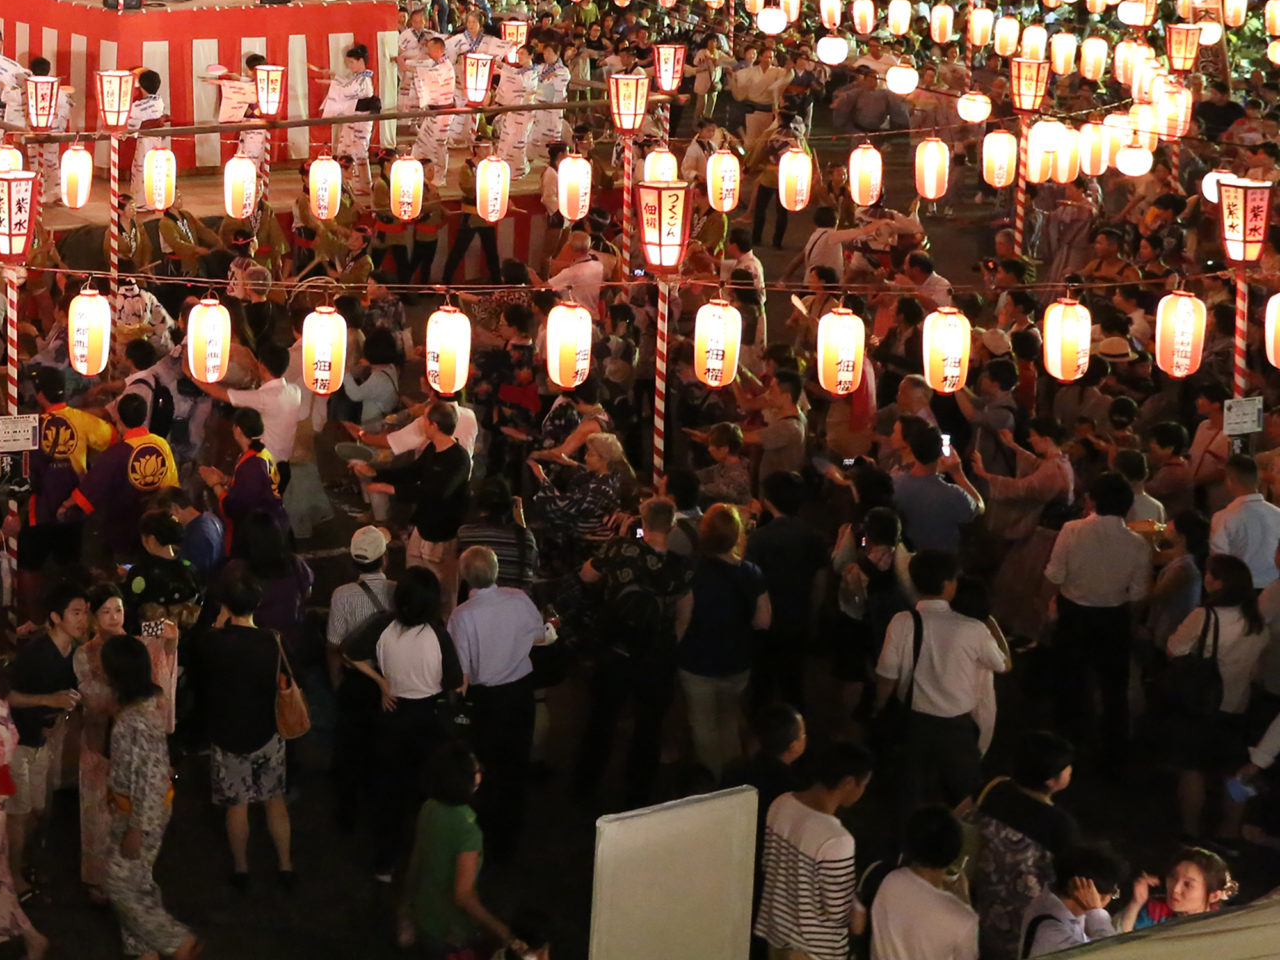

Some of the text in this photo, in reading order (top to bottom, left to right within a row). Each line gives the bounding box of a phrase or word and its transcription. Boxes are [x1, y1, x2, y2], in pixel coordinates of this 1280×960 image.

[12, 197, 29, 232] 紫水
[666, 193, 680, 238] つくごん
